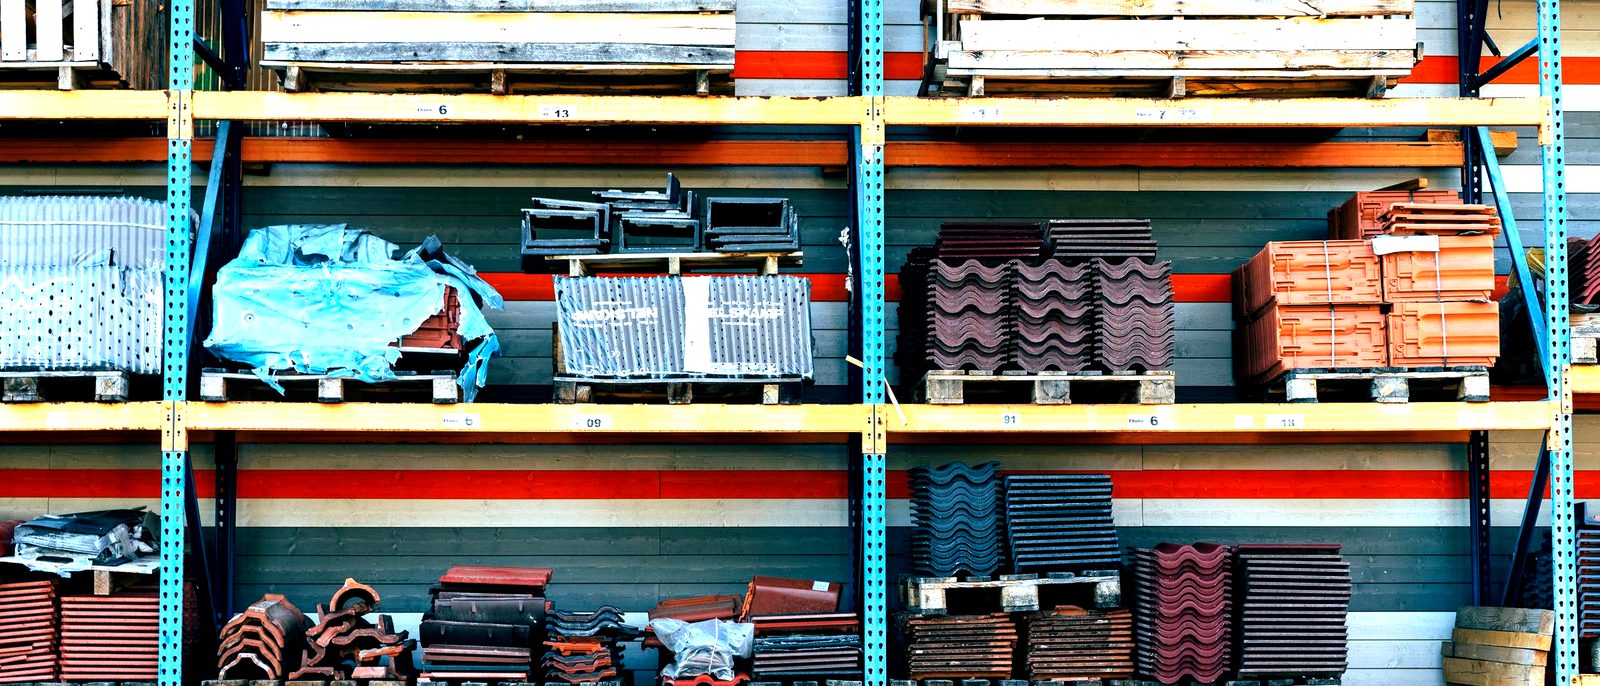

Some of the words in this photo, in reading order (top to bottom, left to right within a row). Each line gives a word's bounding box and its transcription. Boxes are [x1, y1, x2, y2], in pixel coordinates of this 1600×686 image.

[438, 104, 448, 115] 6
[554, 109, 569, 118] 13
[704, 307, 784, 320] ELSKAMP
[586, 418, 602, 428] 09
[1150, 415, 1159, 426] 6
